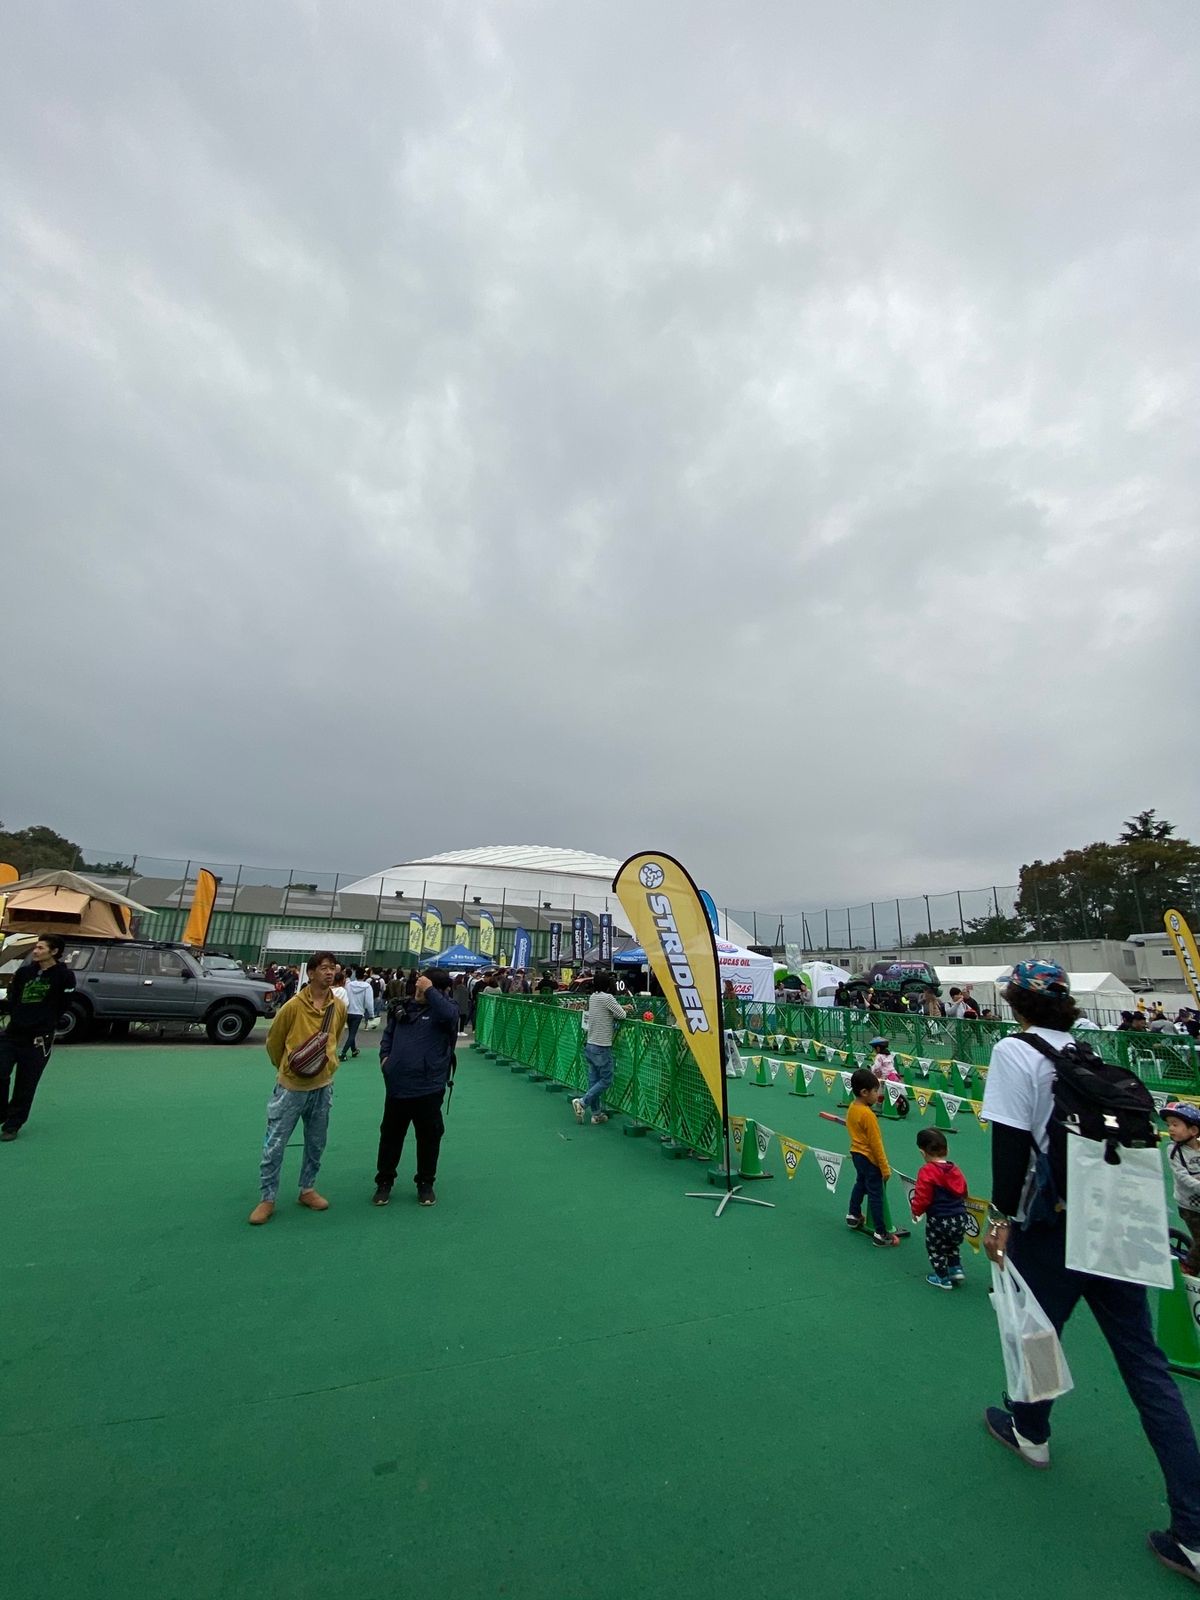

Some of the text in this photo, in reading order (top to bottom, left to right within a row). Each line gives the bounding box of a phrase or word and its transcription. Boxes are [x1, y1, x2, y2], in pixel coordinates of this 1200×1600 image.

[646, 892, 710, 1035] STRIDER
[719, 957, 751, 967] LUCAS OIL
[1174, 933, 1200, 1000] STRID
[615, 980, 626, 991] 10
